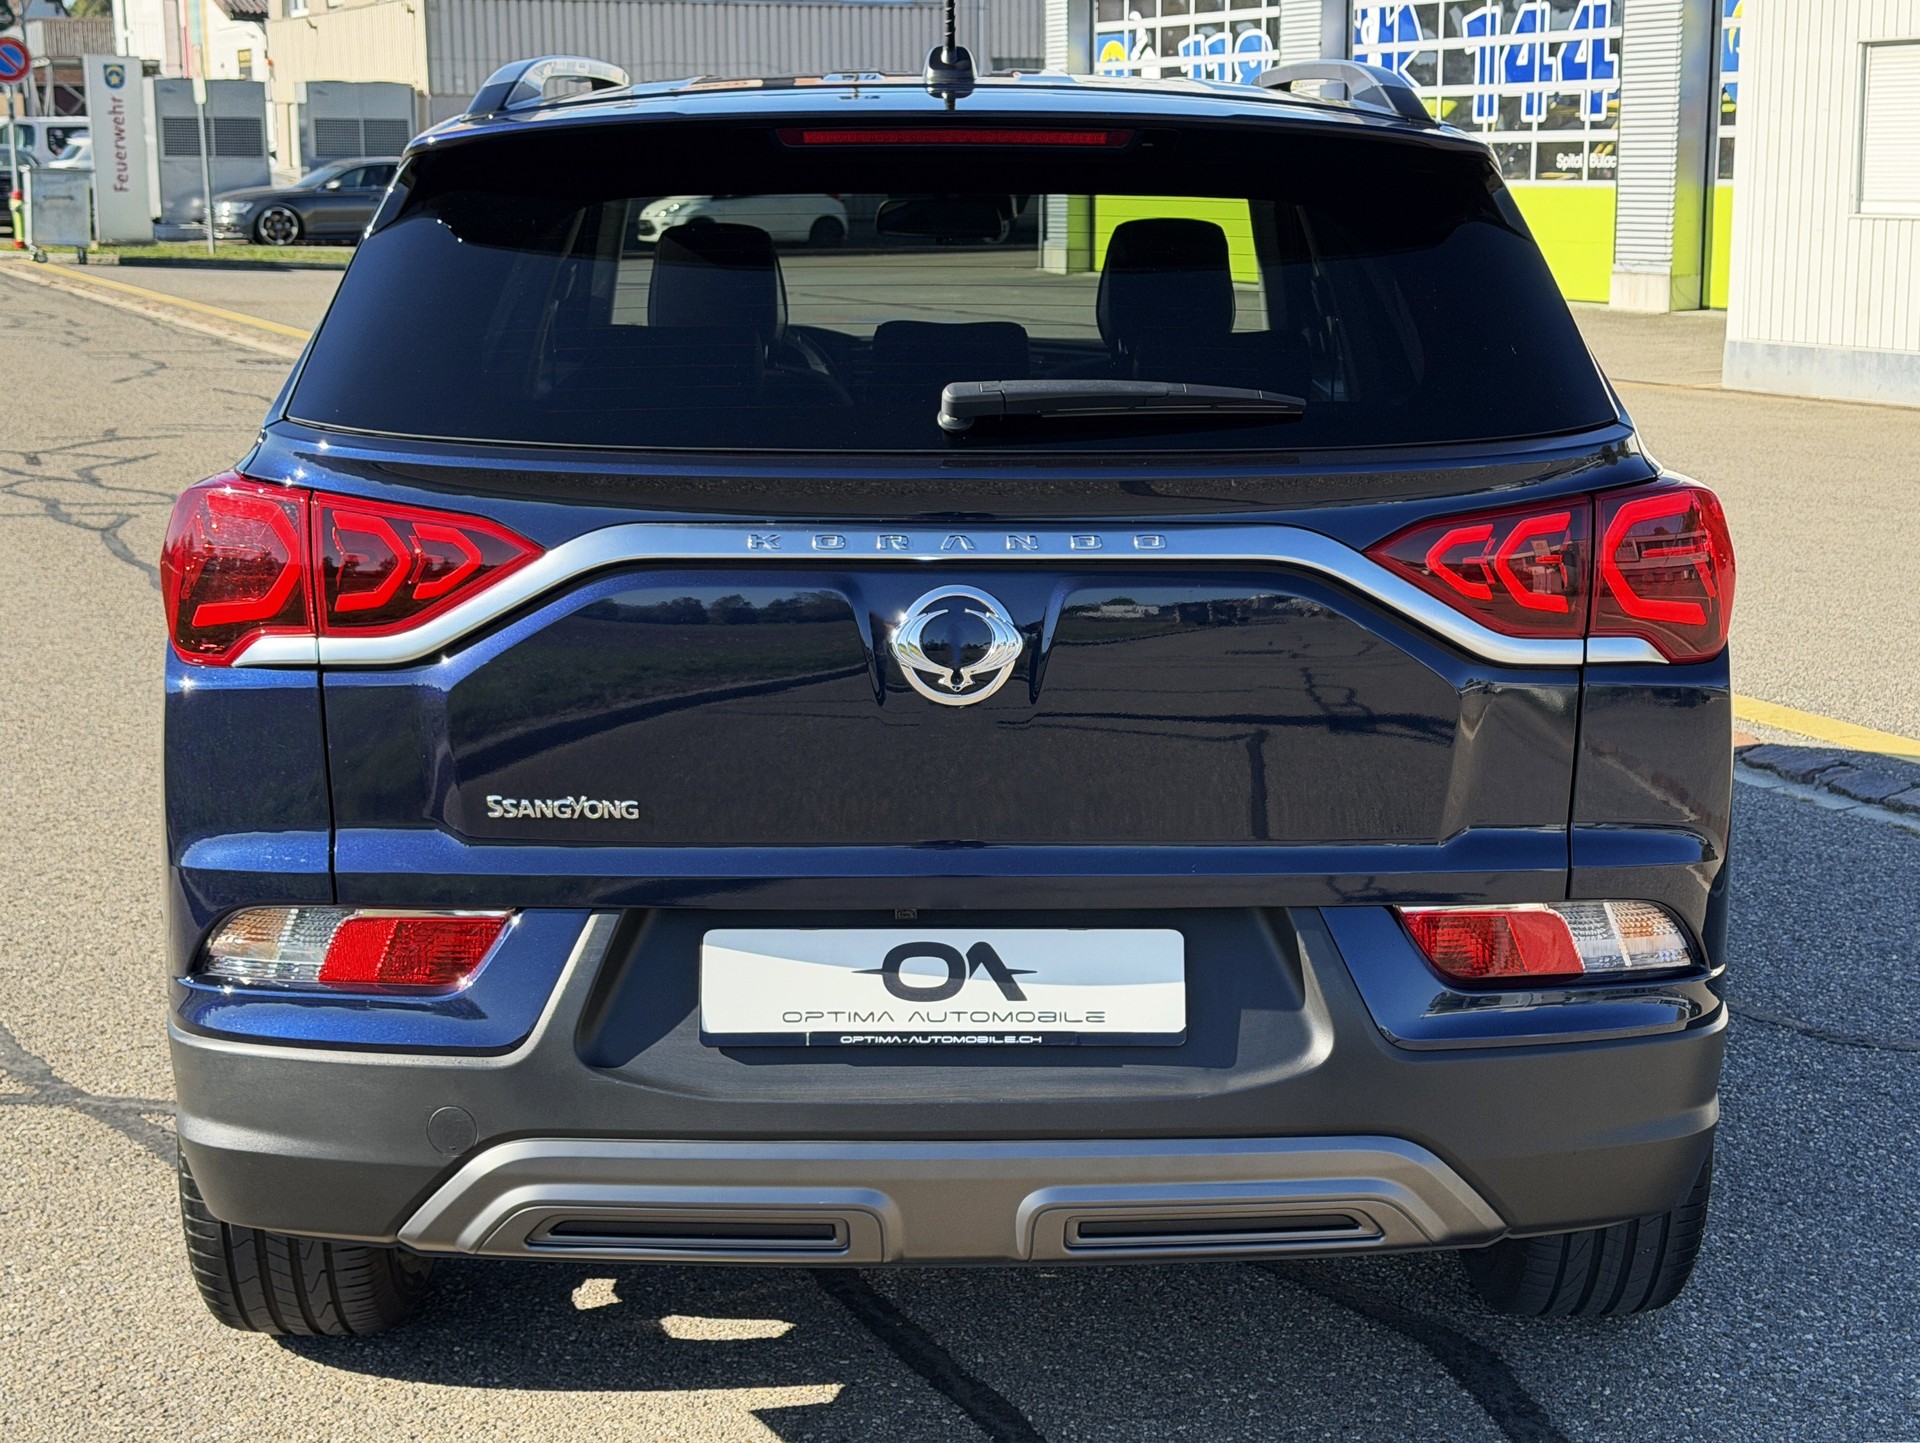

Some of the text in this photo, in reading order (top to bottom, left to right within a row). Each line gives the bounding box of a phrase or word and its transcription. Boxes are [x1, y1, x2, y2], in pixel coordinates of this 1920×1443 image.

[1462, 0, 1619, 124] 144
[107, 96, 130, 193] Feuerwehr
[747, 534, 1167, 549] KORANDO
[485, 795, 640, 819] SSANGYONG
[782, 1011, 1106, 1023] OPTIMA AUTOMOBILE
[840, 1035, 1042, 1045] OPTIMA-AUTOMOBILE.CH
